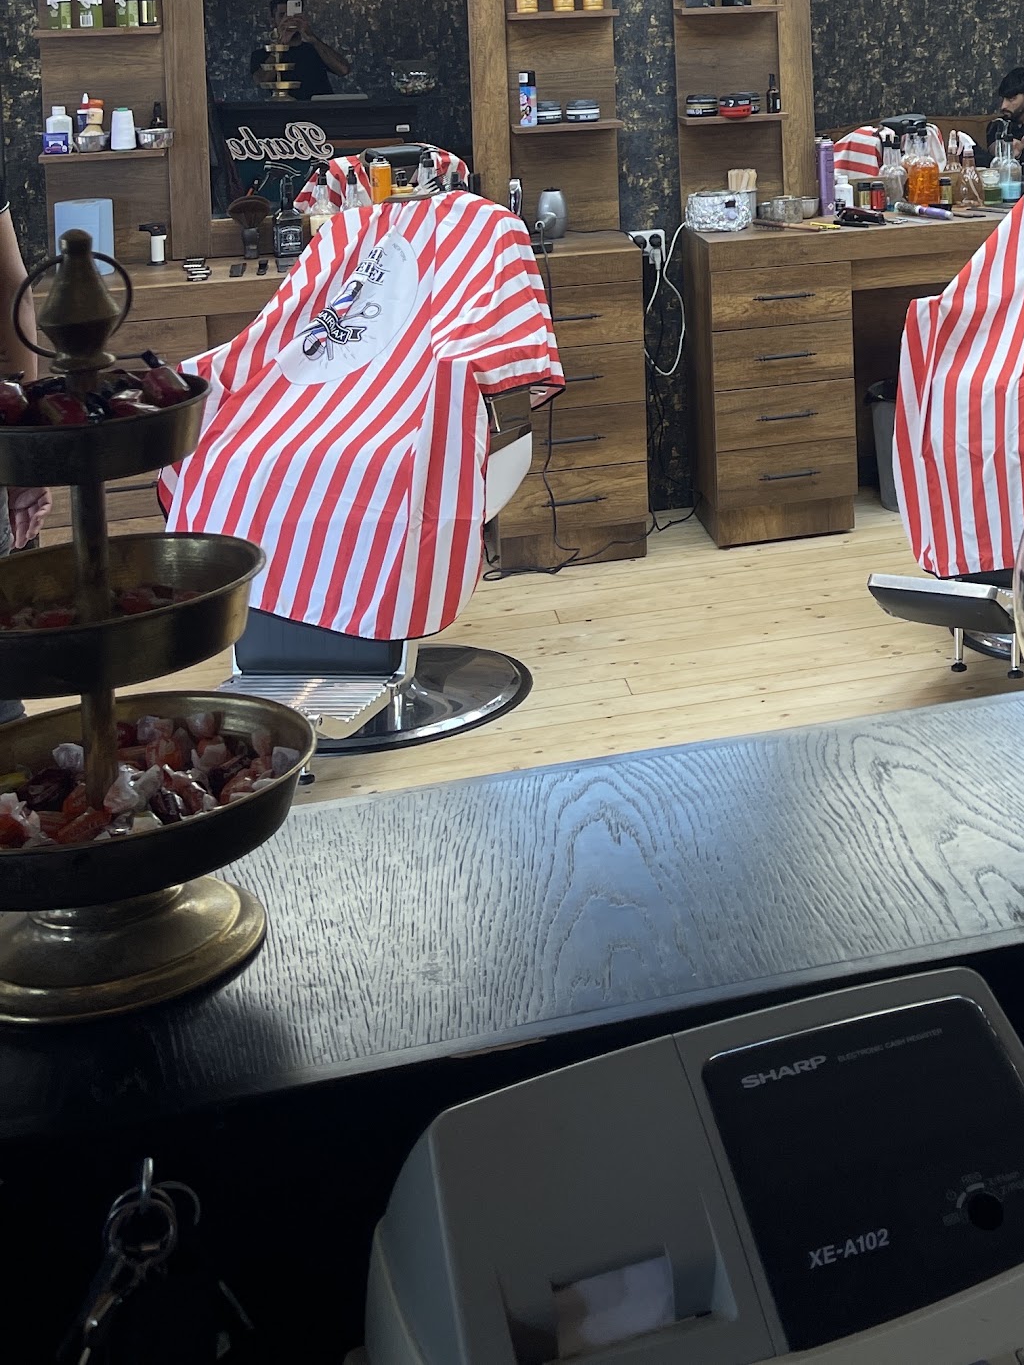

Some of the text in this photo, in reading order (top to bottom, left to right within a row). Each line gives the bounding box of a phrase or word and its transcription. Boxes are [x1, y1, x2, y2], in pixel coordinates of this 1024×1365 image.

[741, 1027, 943, 1089] SHARP ELECTRONIC CASH REGISTER
[808, 1227, 890, 1270] XE-A102
